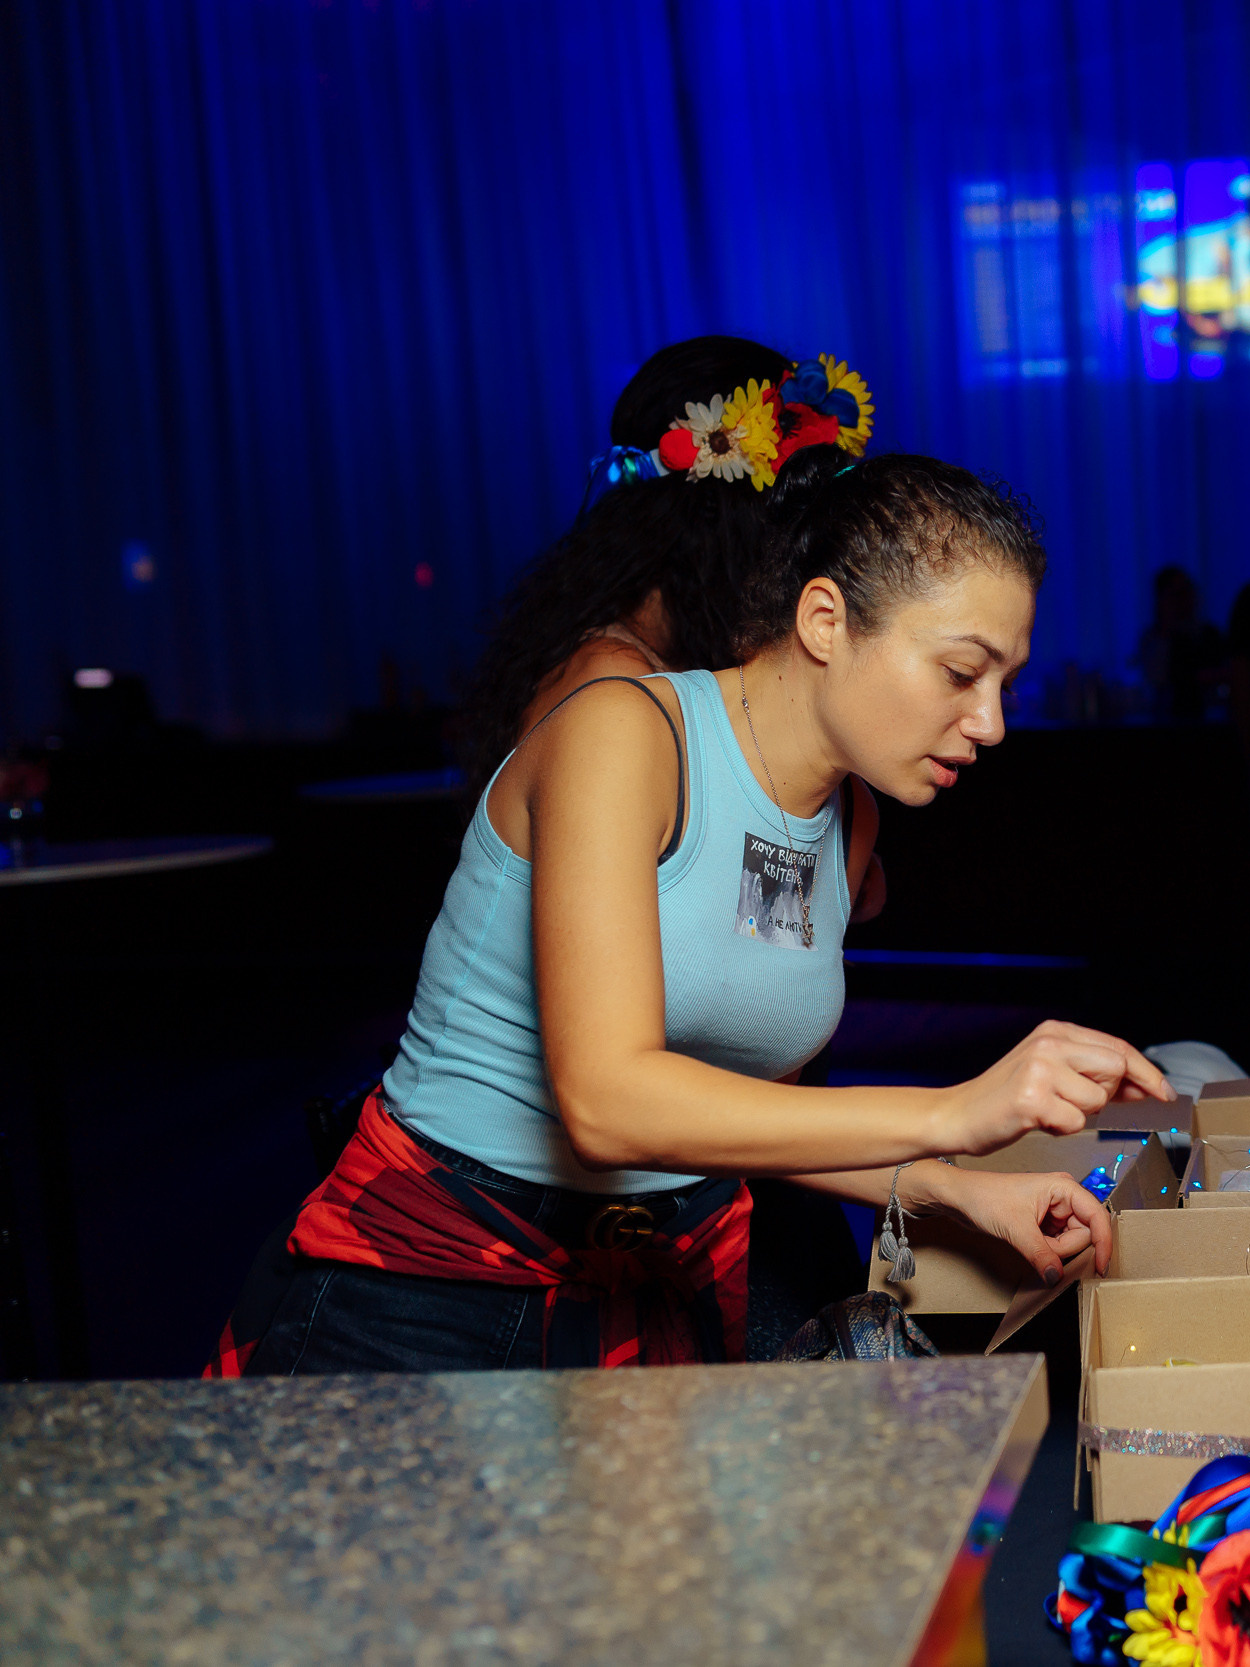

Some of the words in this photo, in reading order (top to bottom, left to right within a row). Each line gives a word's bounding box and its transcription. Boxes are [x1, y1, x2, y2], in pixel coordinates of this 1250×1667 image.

[750, 839, 776, 859] ХОЧУ
[767, 915, 773, 926] А
[775, 917, 784, 930] НЕ
